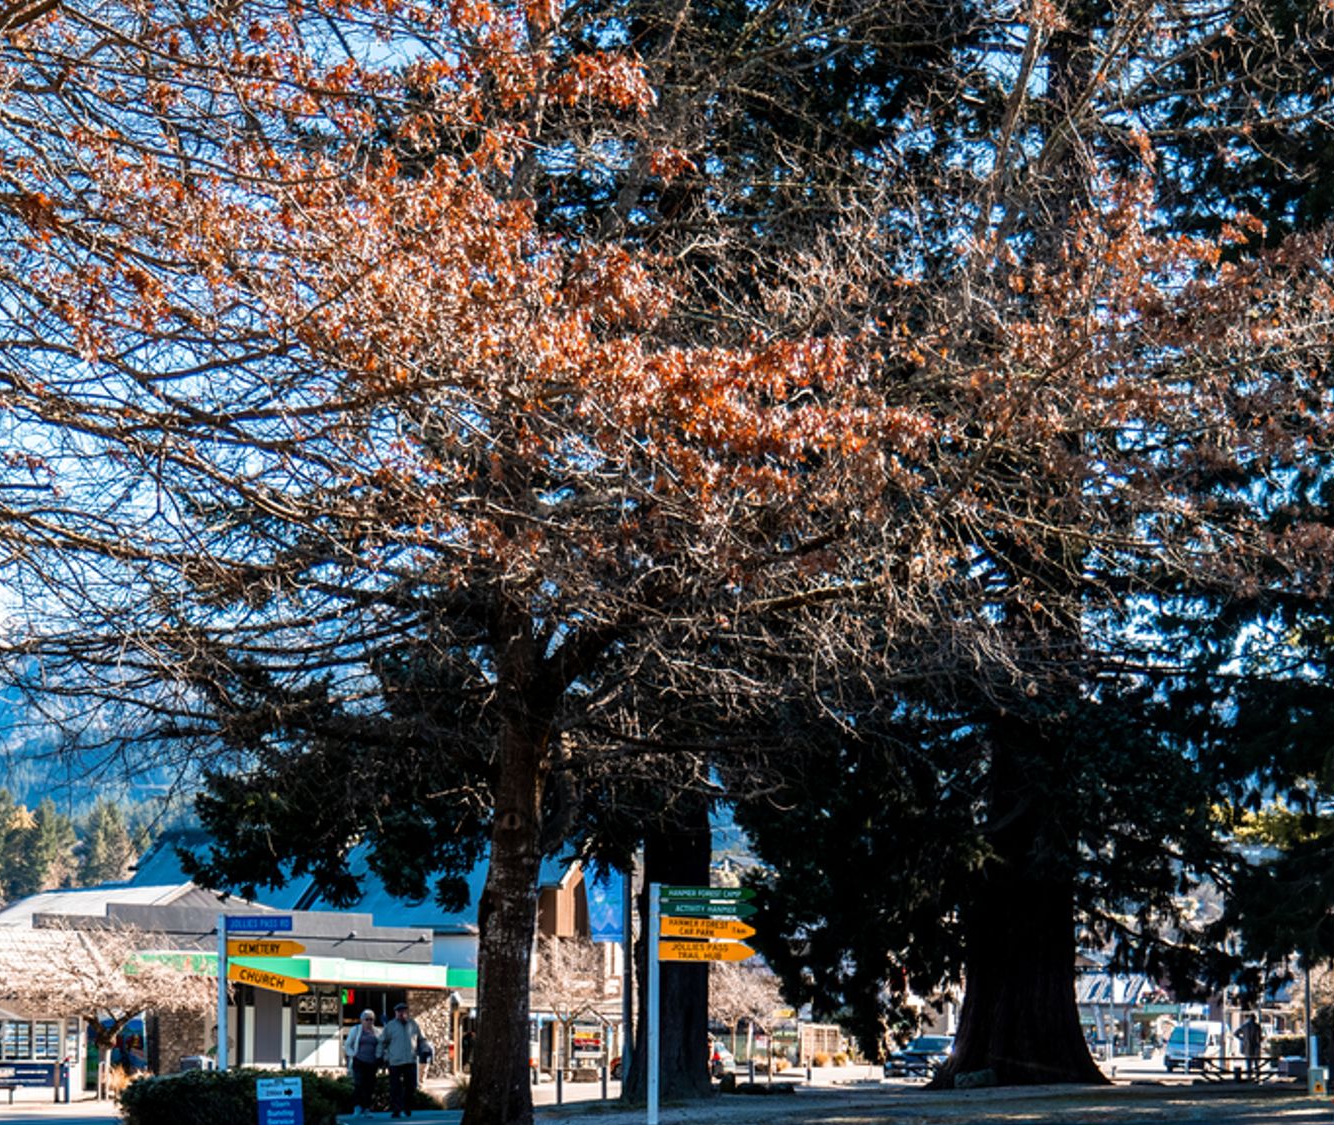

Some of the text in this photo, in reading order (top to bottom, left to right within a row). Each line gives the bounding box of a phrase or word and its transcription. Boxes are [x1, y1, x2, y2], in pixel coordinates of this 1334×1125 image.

[668, 889, 742, 898] HANMER FOREST CAMP
[675, 905, 705, 913] ACTIVITY
[701, 921, 728, 929] FOREST
[679, 927, 714, 936] CAR PARK
[238, 943, 281, 955] CEMETERY
[671, 943, 704, 951] JOLLIES
[239, 969, 285, 988] CHURCH
